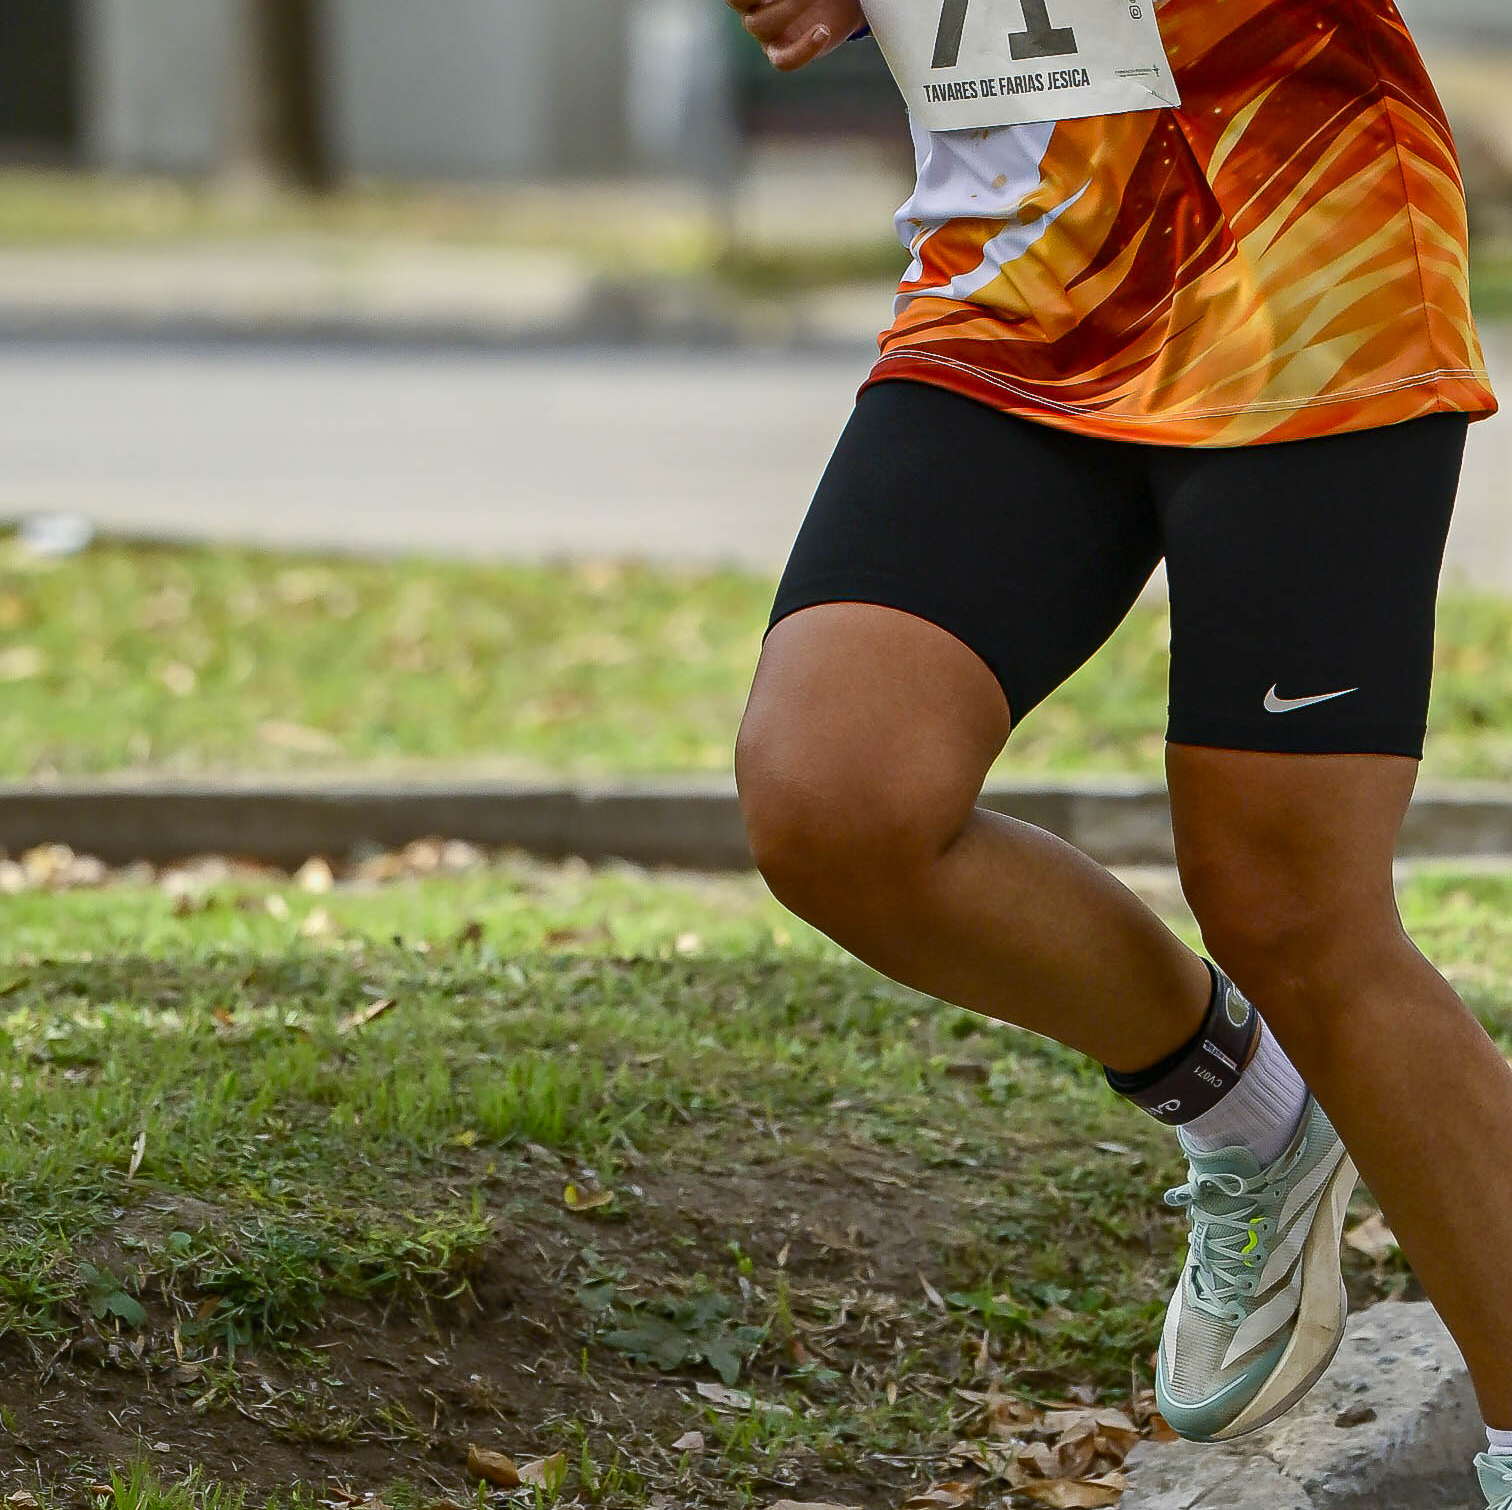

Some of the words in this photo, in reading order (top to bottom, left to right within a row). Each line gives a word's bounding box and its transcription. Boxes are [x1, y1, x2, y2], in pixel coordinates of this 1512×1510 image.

[923, 80, 978, 103] TAVARES
[979, 79, 997, 97] DE
[1000, 73, 1044, 95] FARIAS
[1047, 68, 1091, 91] JESICA
[1193, 1066, 1223, 1088] CV071
